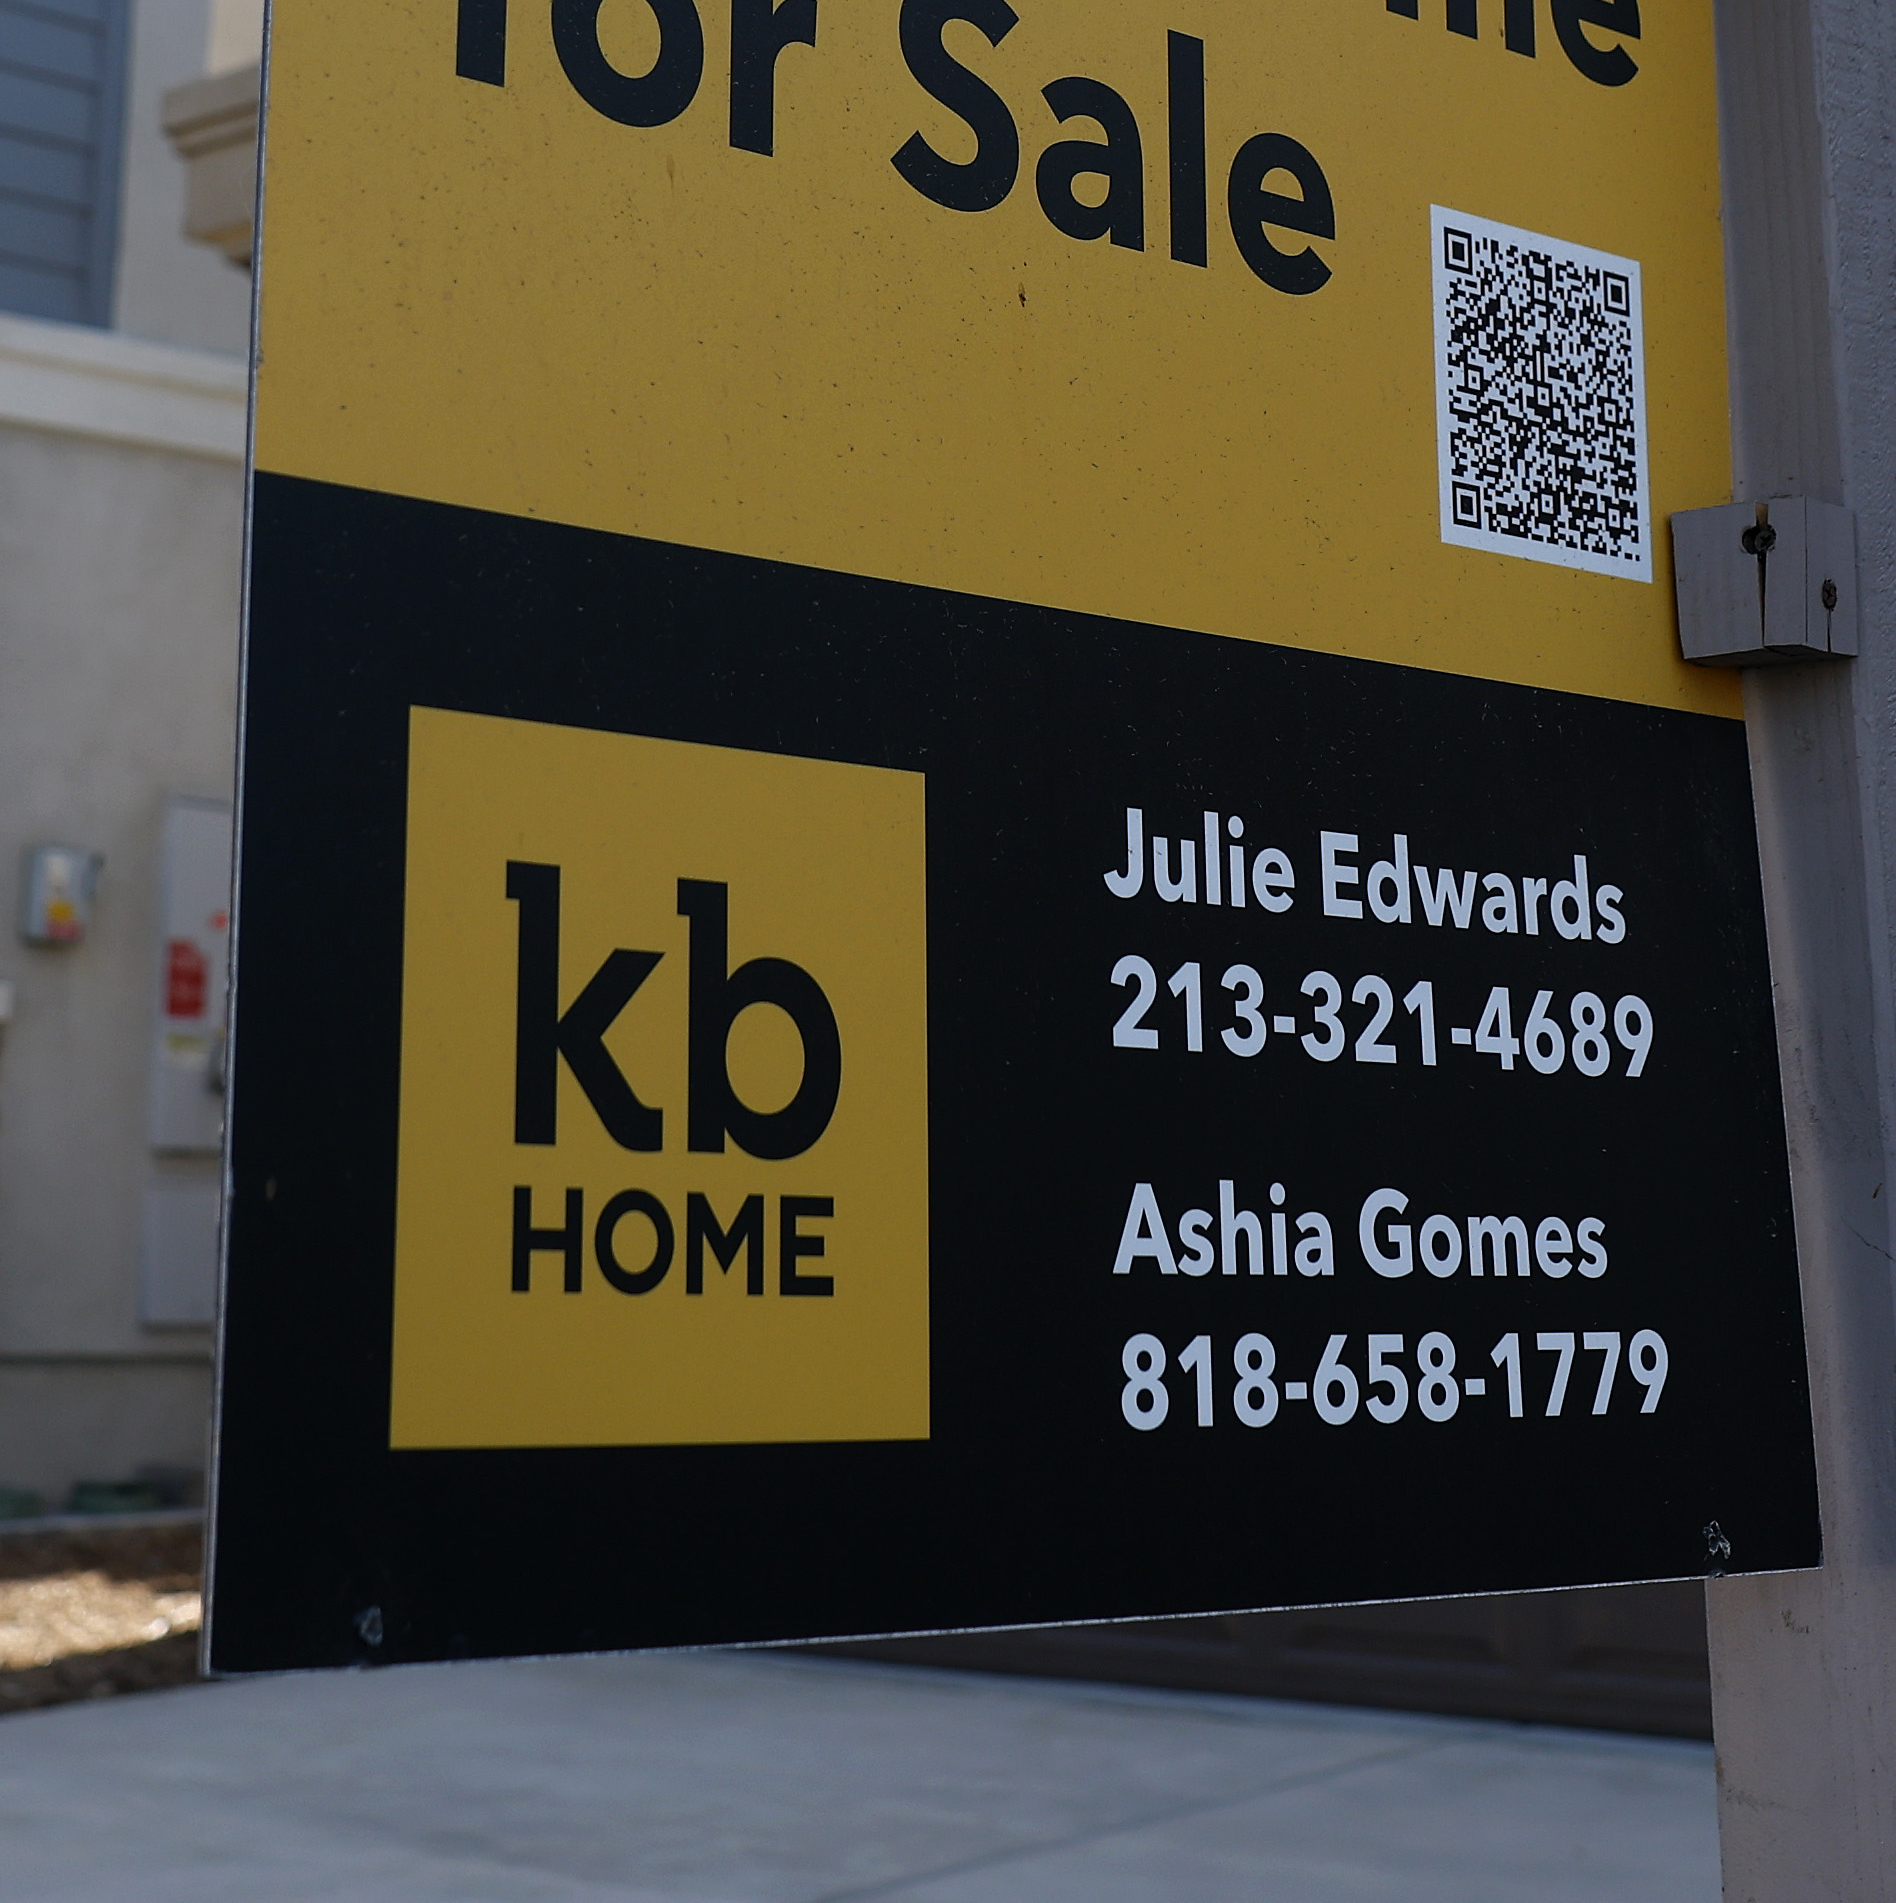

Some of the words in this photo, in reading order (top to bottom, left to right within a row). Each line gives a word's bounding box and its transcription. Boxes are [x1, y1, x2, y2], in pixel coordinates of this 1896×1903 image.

[1104, 808, 1295, 912] Julie
[1321, 831, 1625, 943] Edwards
[506, 860, 841, 1161] kb
[1111, 955, 1653, 1077] 213-321-4689
[511, 1185, 834, 1297] HOME
[1113, 1180, 1334, 1276] Ashia
[1359, 1188, 1607, 1278] Gomes
[1122, 1329, 1668, 1430] 818-658-1779
